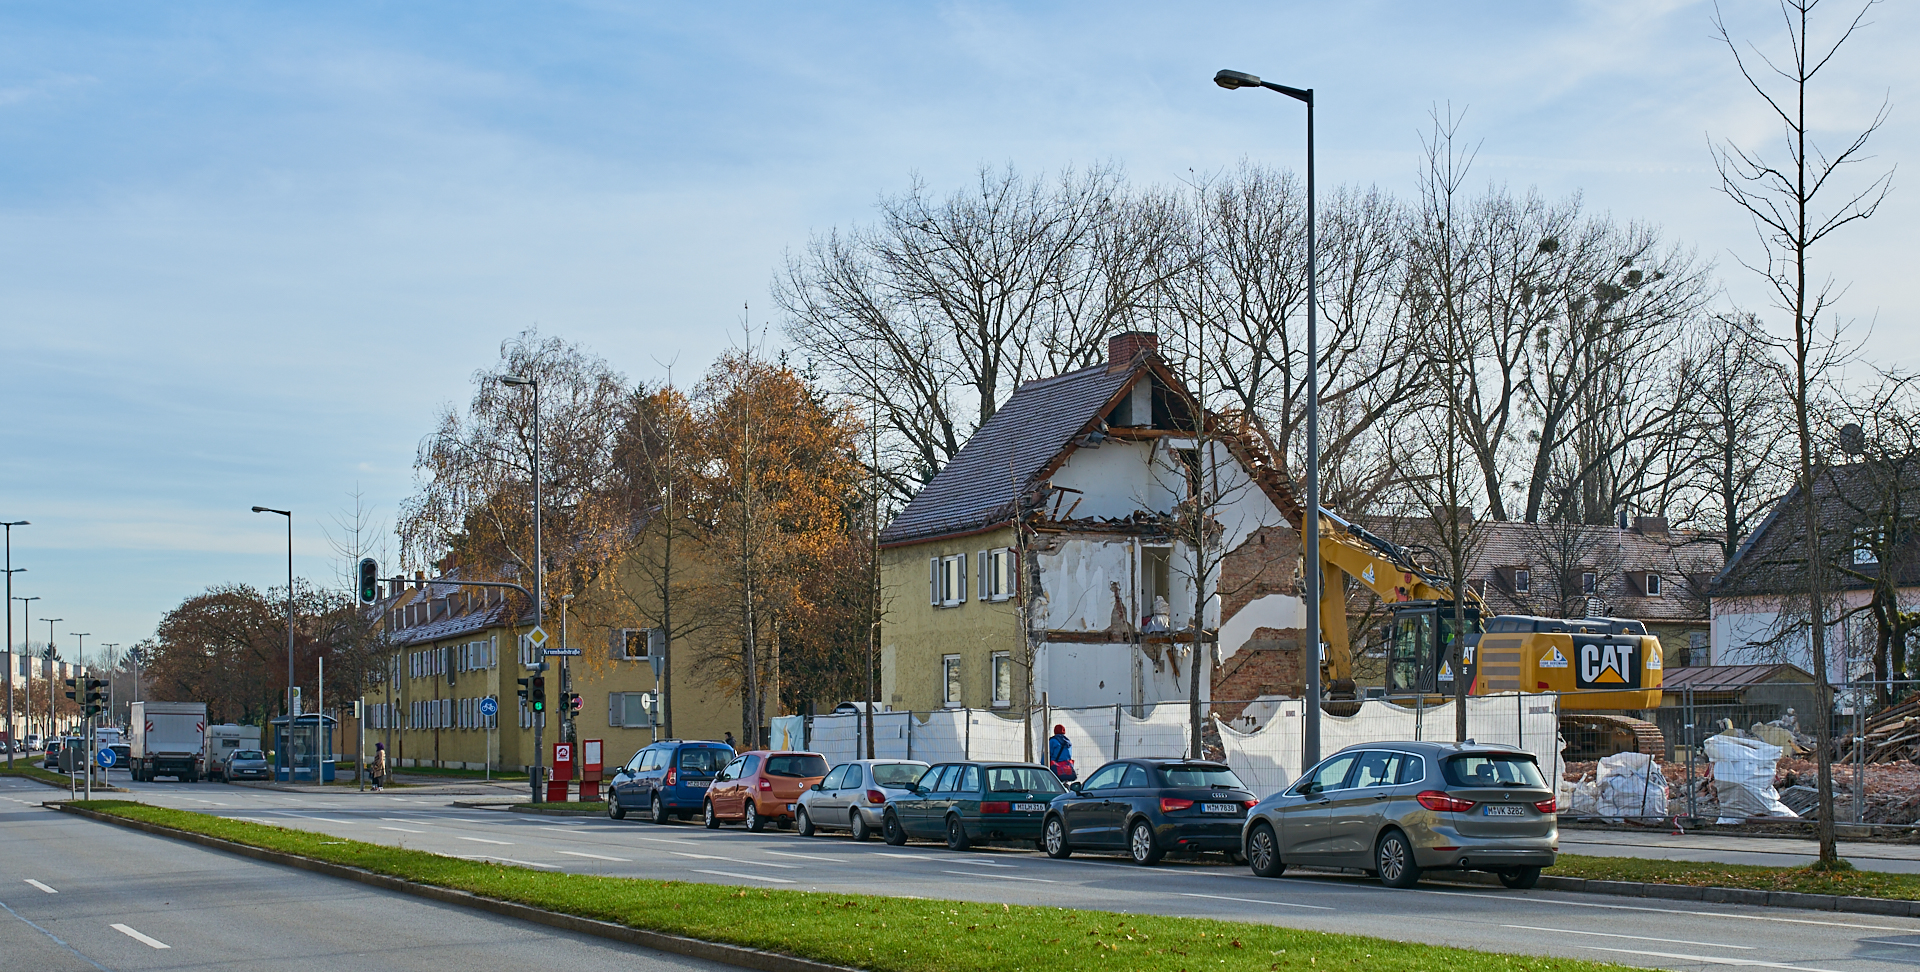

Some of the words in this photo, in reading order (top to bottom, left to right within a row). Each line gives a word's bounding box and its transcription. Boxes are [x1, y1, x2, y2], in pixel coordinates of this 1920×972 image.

[1463, 647, 1475, 664] AT
[1581, 644, 1633, 683] CAT
[1496, 806, 1506, 815] VK
